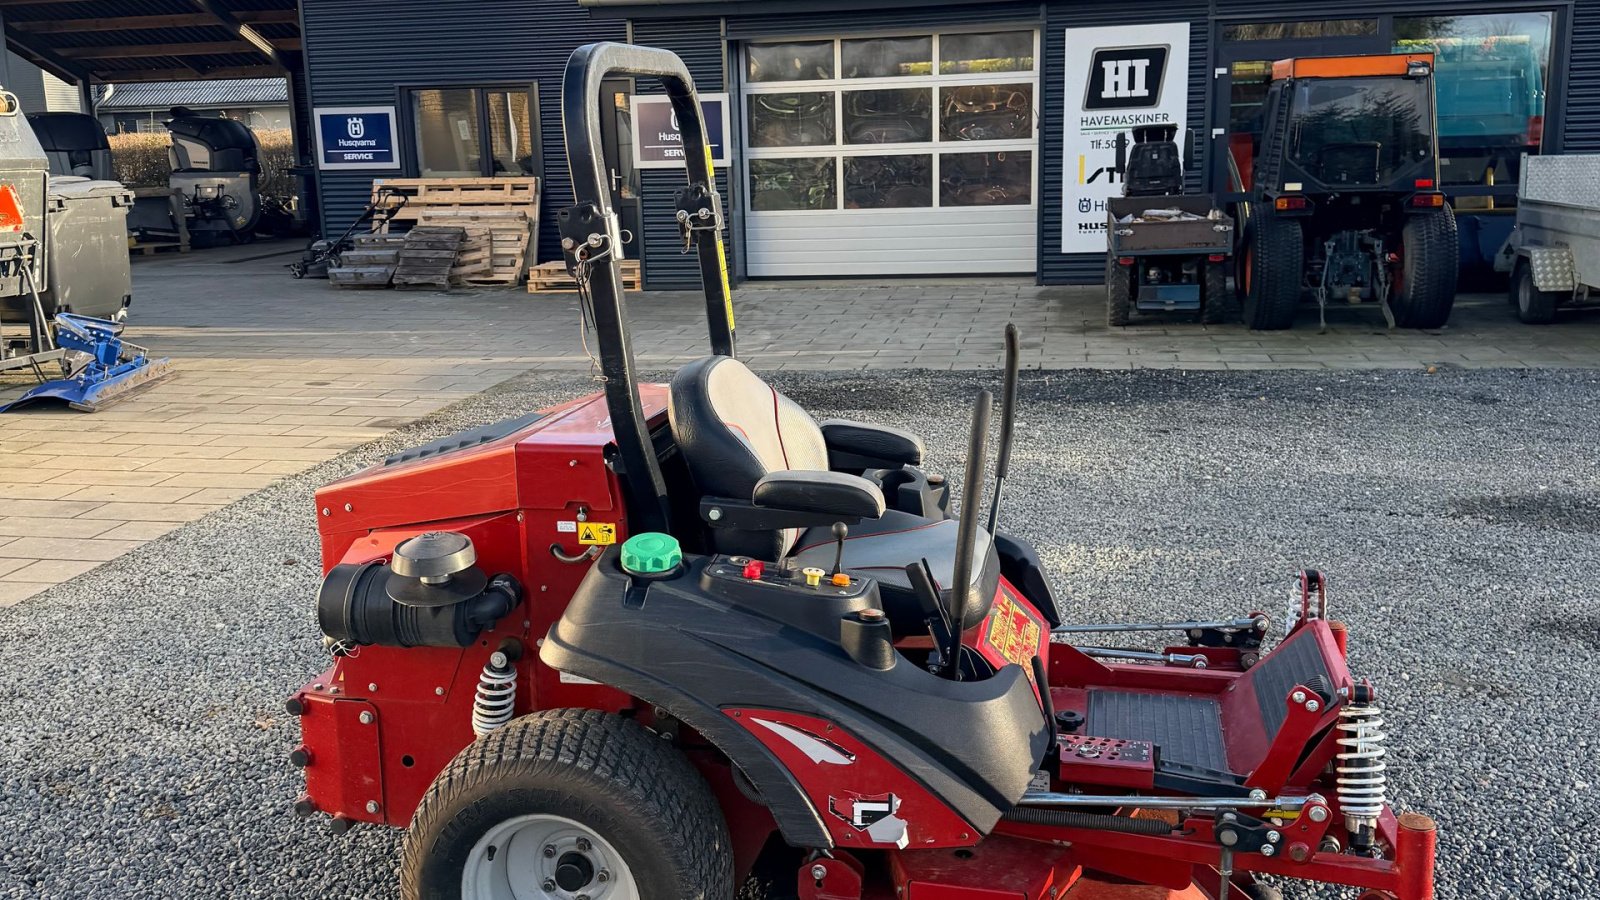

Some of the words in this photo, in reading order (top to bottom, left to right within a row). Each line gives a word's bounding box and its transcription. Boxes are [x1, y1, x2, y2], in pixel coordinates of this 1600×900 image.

[1101, 59, 1150, 98] HI
[1080, 113, 1169, 126] HAVEMASKINER
[338, 139, 376, 148] Husqvarna
